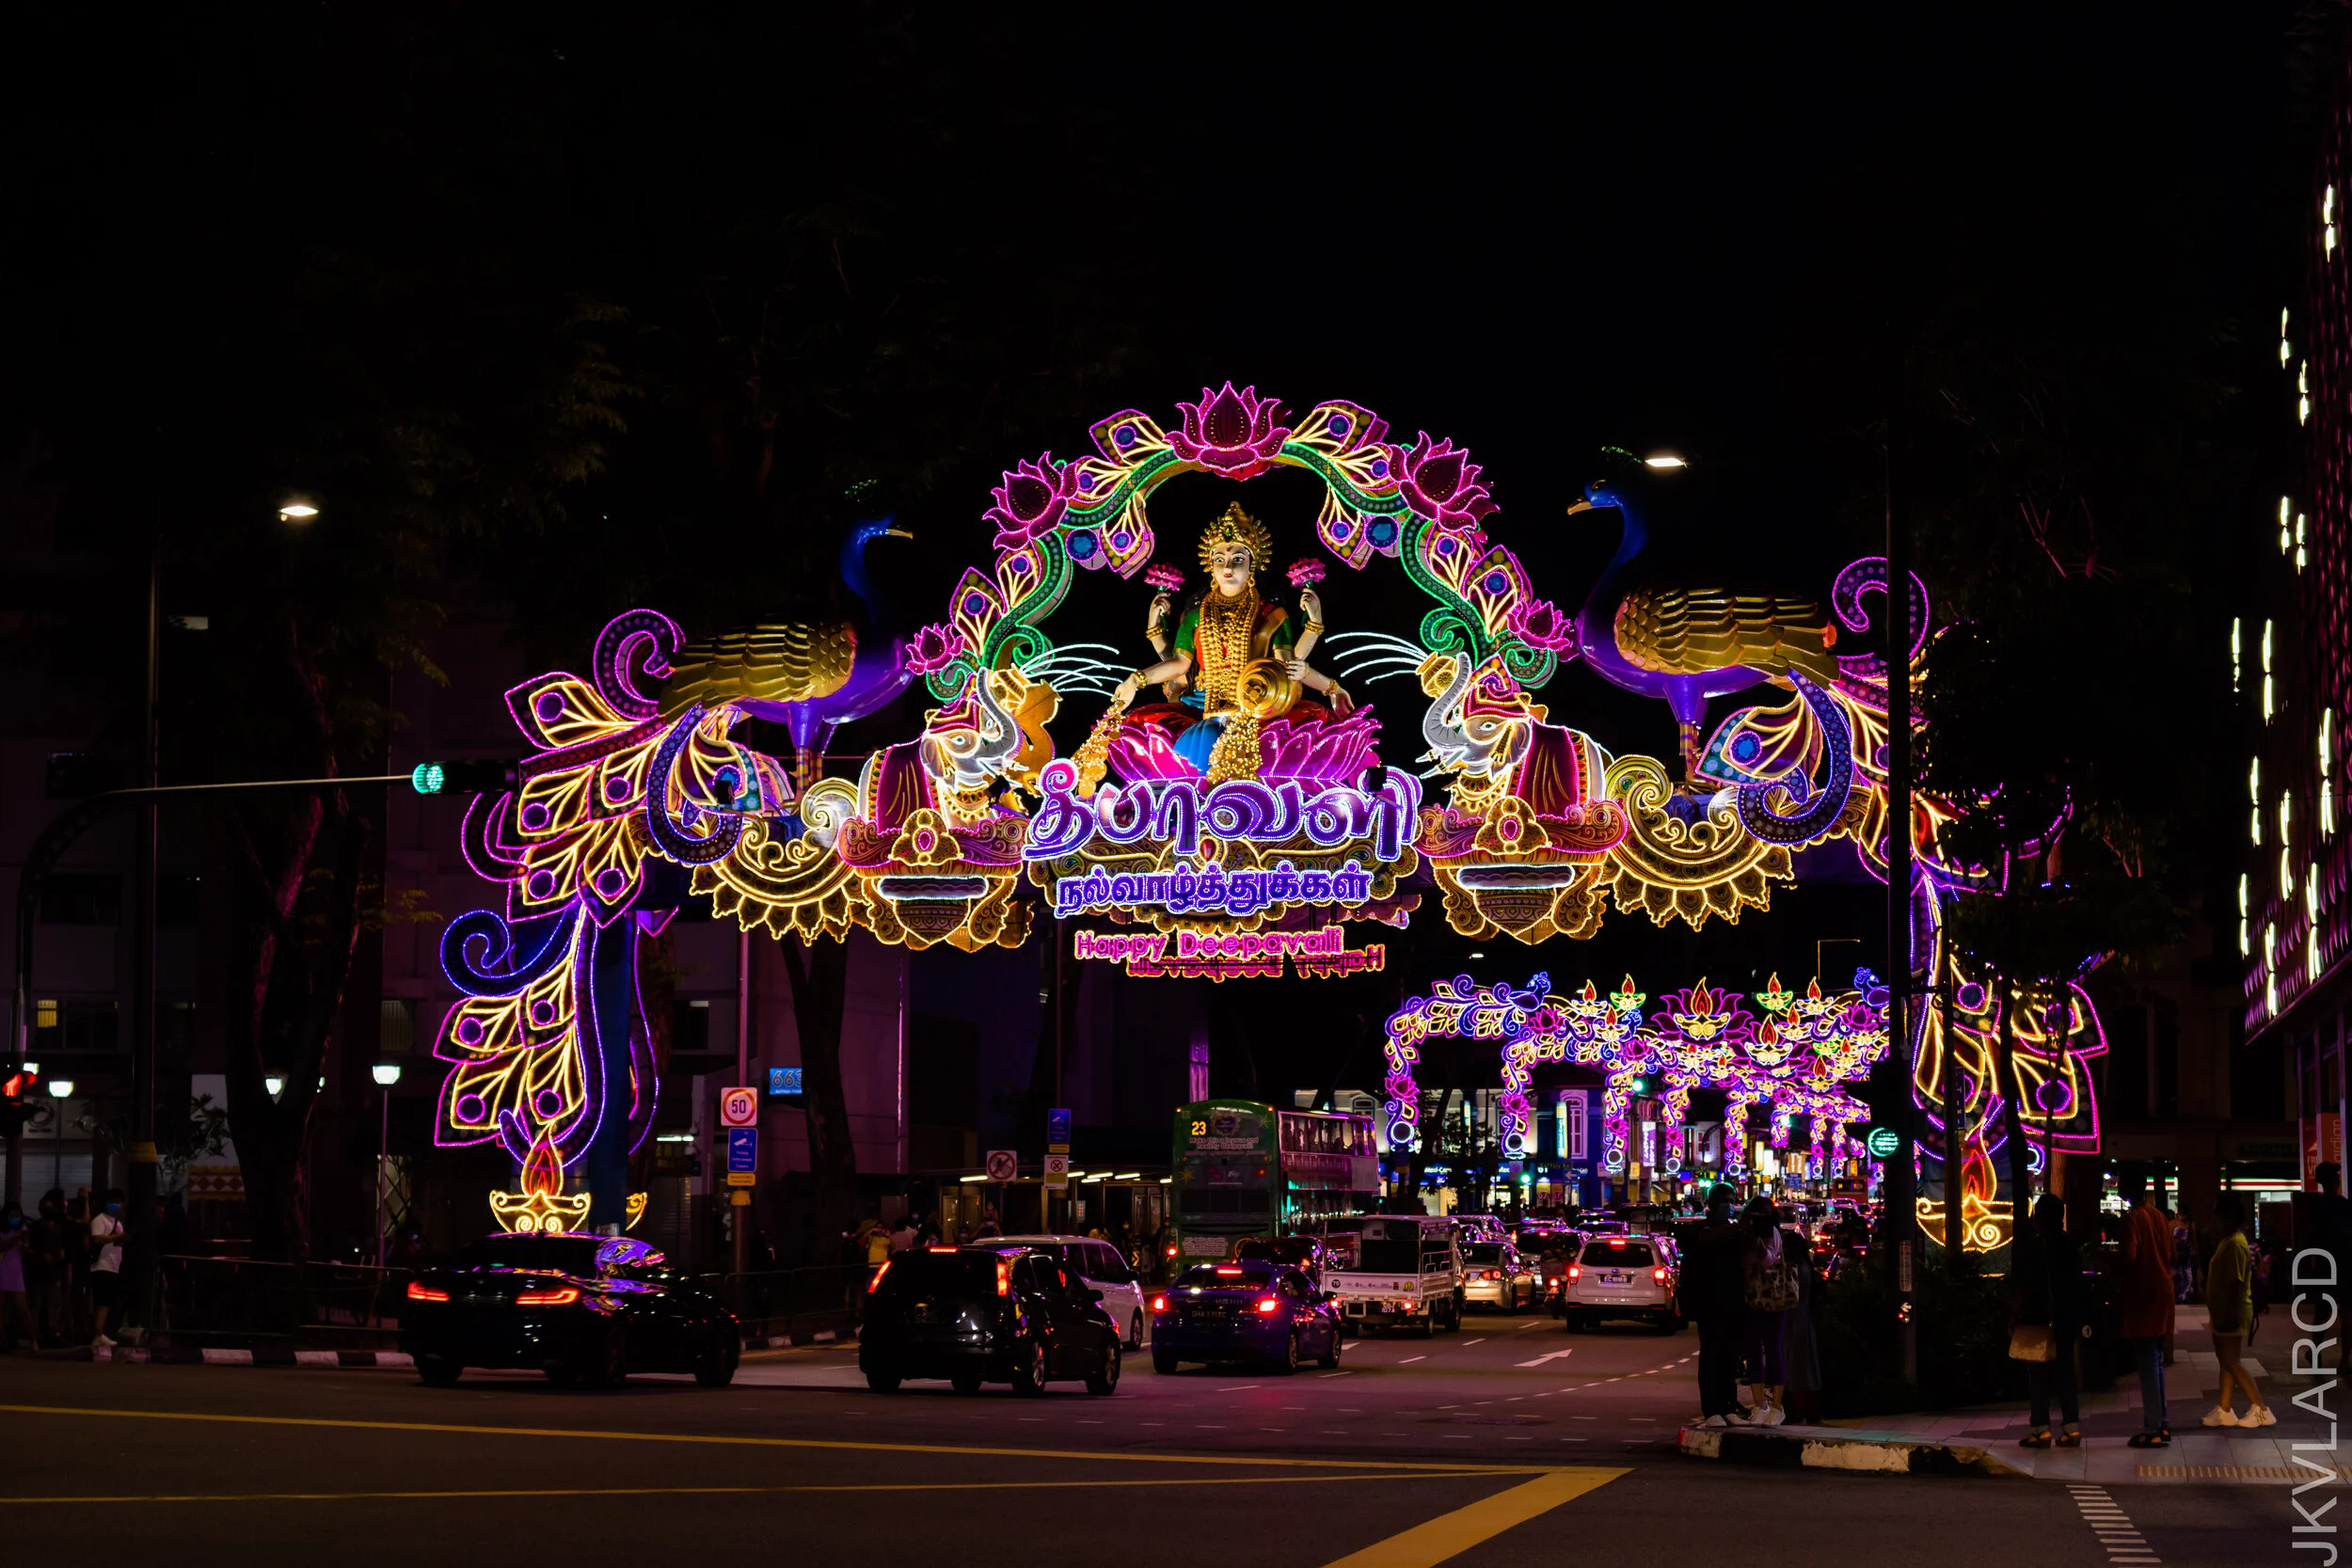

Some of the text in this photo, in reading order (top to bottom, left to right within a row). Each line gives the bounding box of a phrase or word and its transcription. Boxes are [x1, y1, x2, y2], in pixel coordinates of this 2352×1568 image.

[1022, 758, 1422, 862] தீபாவளி
[1054, 860, 1374, 919] நல்வாழ்த்துக்கள்
[1074, 926, 1344, 963] Happy Deepavali
[731, 1100, 746, 1114] 50
[1191, 1120, 1207, 1135] 23
